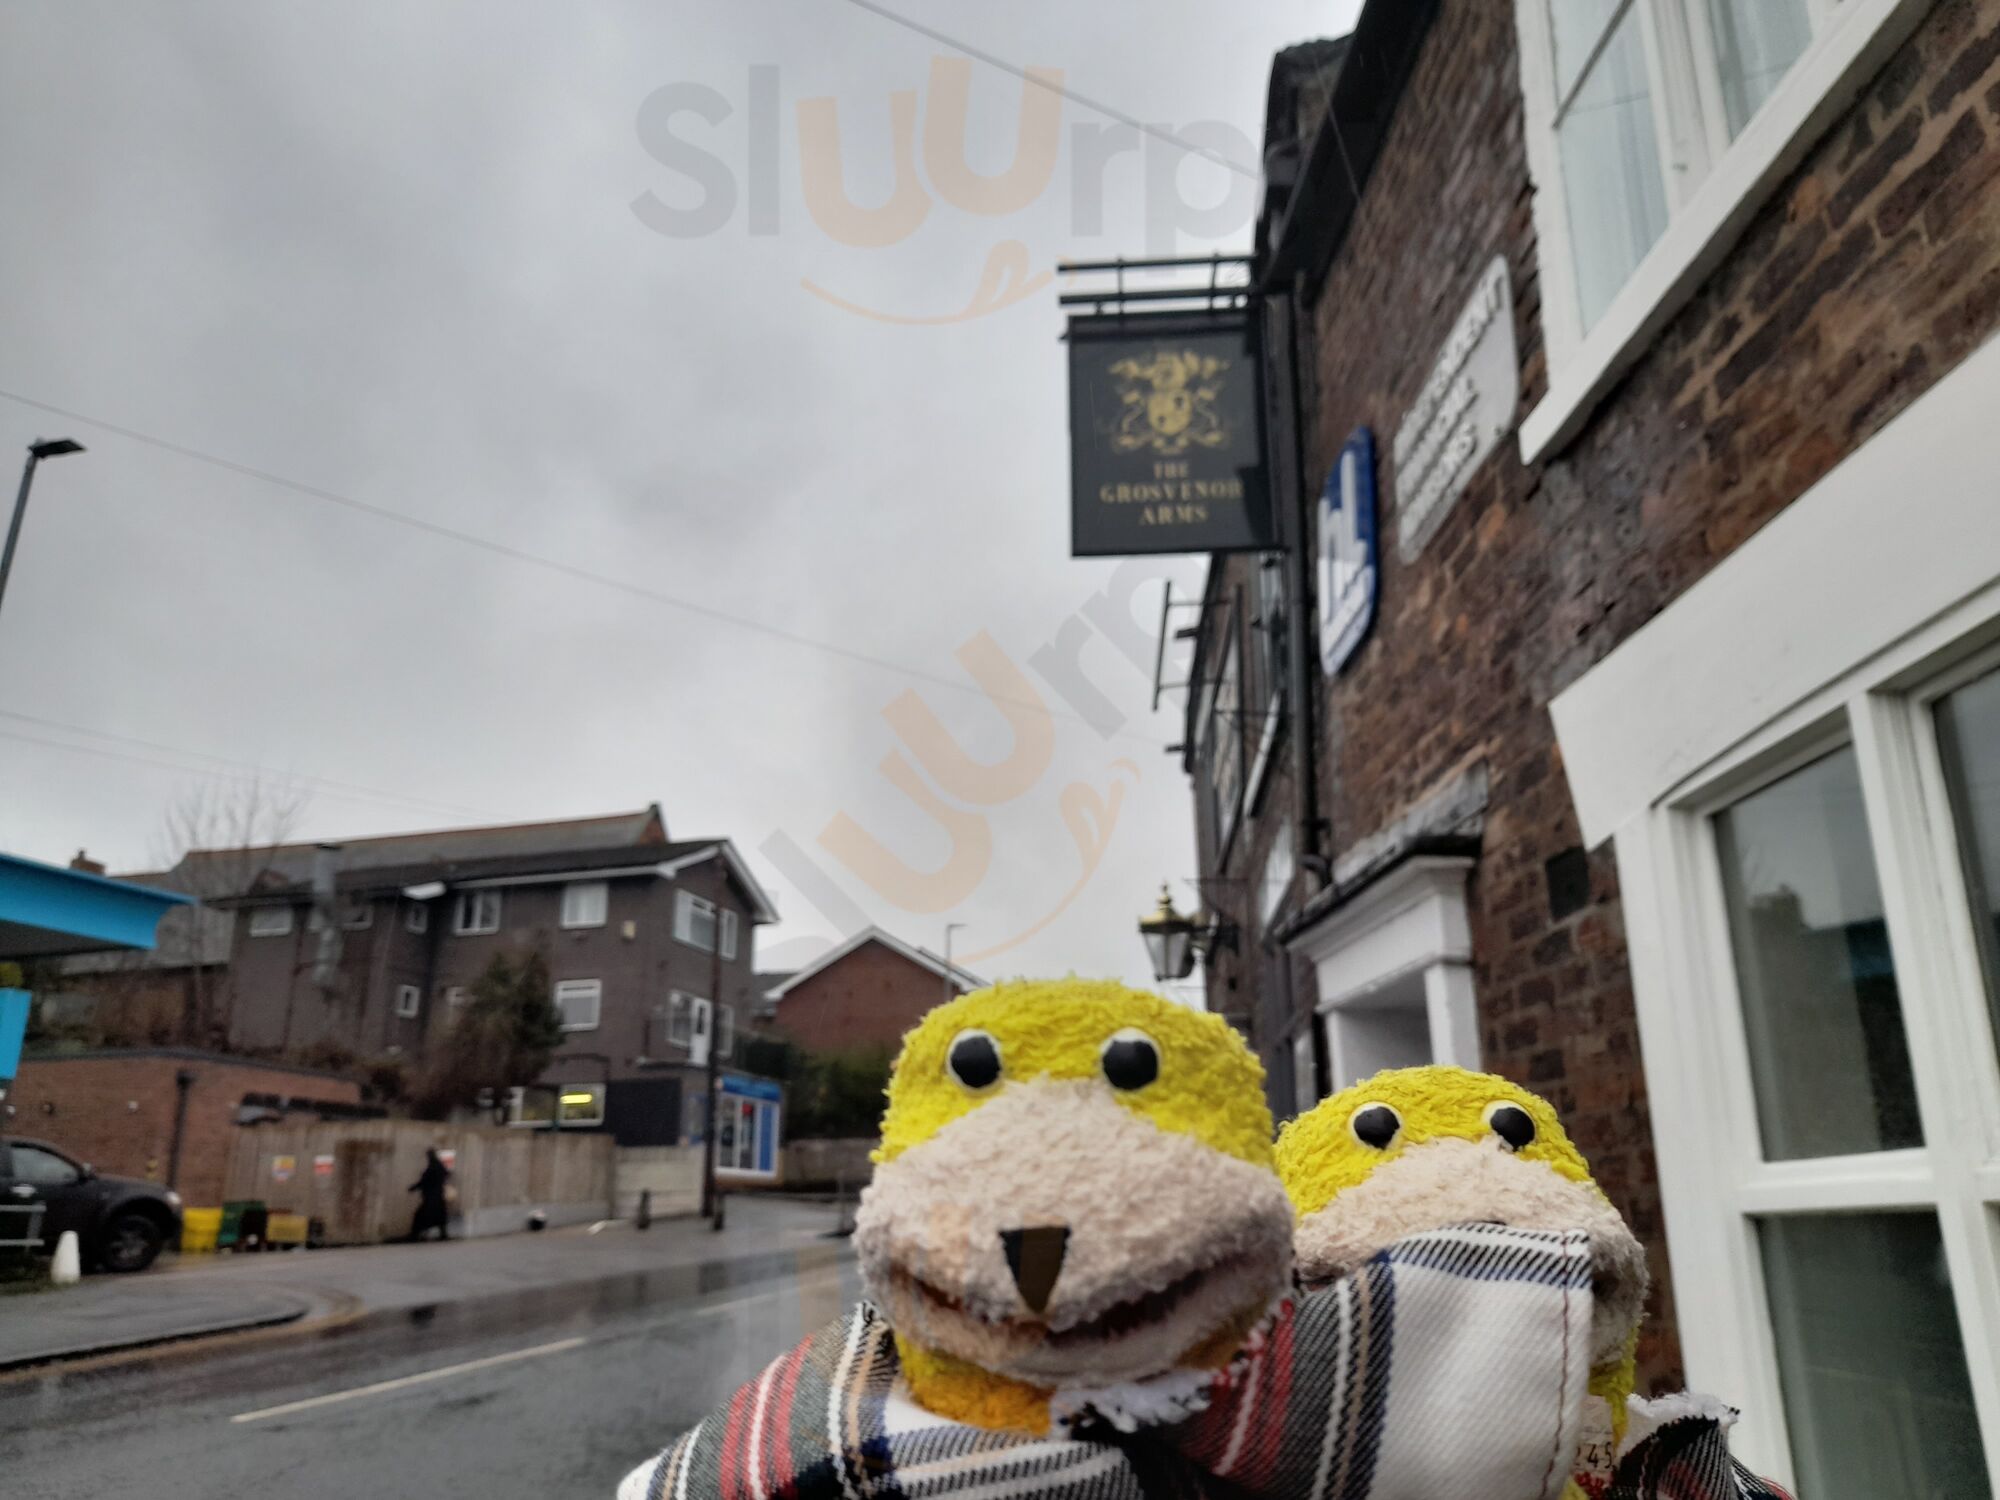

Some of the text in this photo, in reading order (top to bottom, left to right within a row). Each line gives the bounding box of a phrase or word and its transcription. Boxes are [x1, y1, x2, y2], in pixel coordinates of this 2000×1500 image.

[1153, 461, 1189, 479] THE
[1100, 480, 1243, 503] GROSVENOR
[1138, 505, 1208, 525] ARMS
